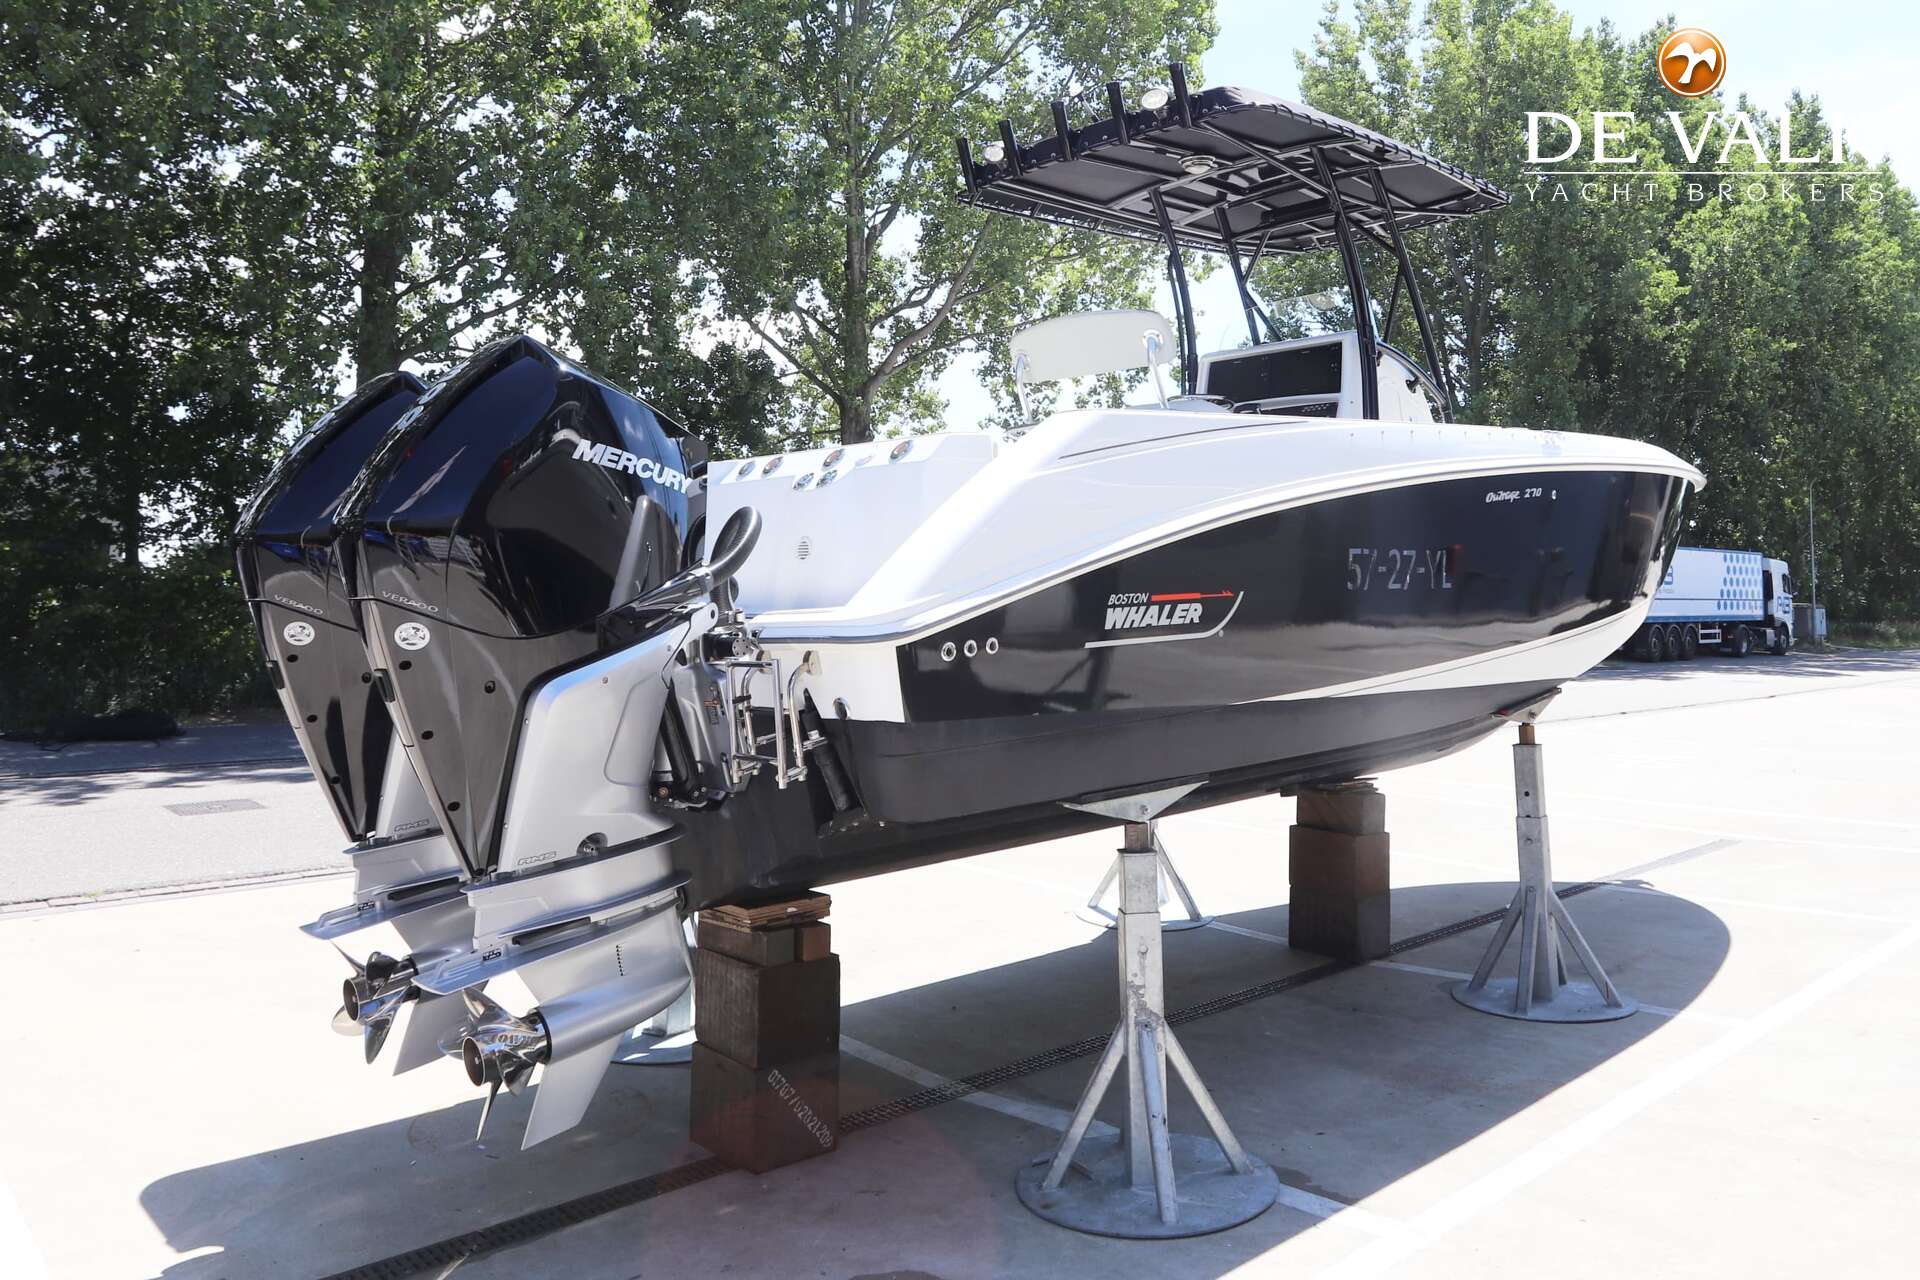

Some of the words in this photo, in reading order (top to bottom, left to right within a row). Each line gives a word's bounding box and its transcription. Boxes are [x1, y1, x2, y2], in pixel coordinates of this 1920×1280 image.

[571, 438, 693, 495] MERCURY
[1523, 487, 1543, 498] 270
[273, 594, 325, 616] VERADO
[381, 590, 440, 614] VERADO
[1108, 592, 1150, 606] BOSTON
[1104, 602, 1203, 630] WHALER
